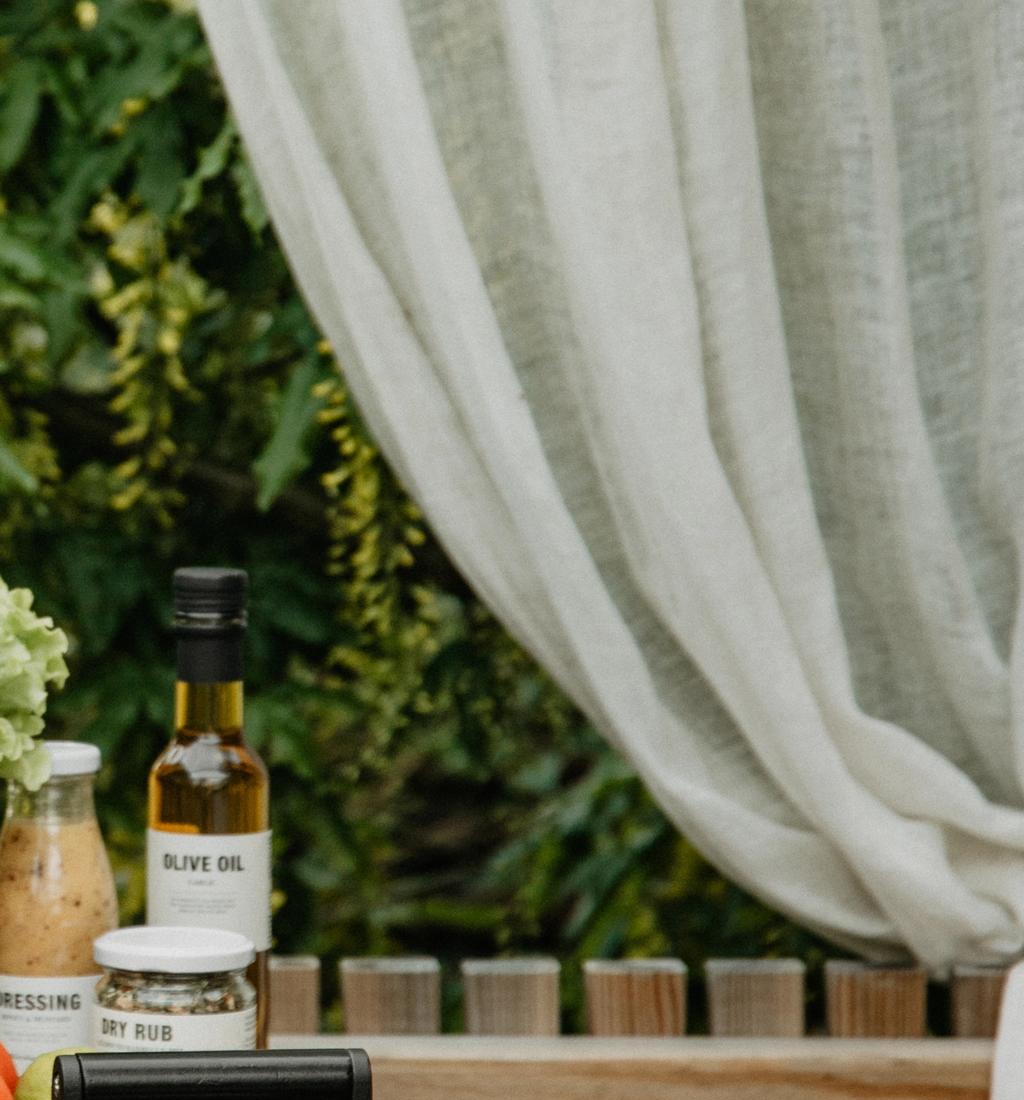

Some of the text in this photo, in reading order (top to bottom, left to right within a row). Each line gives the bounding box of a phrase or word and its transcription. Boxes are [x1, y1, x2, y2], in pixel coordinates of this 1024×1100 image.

[163, 853, 245, 873] OLIVE OIL
[101, 1017, 173, 1043] DRY RUB
